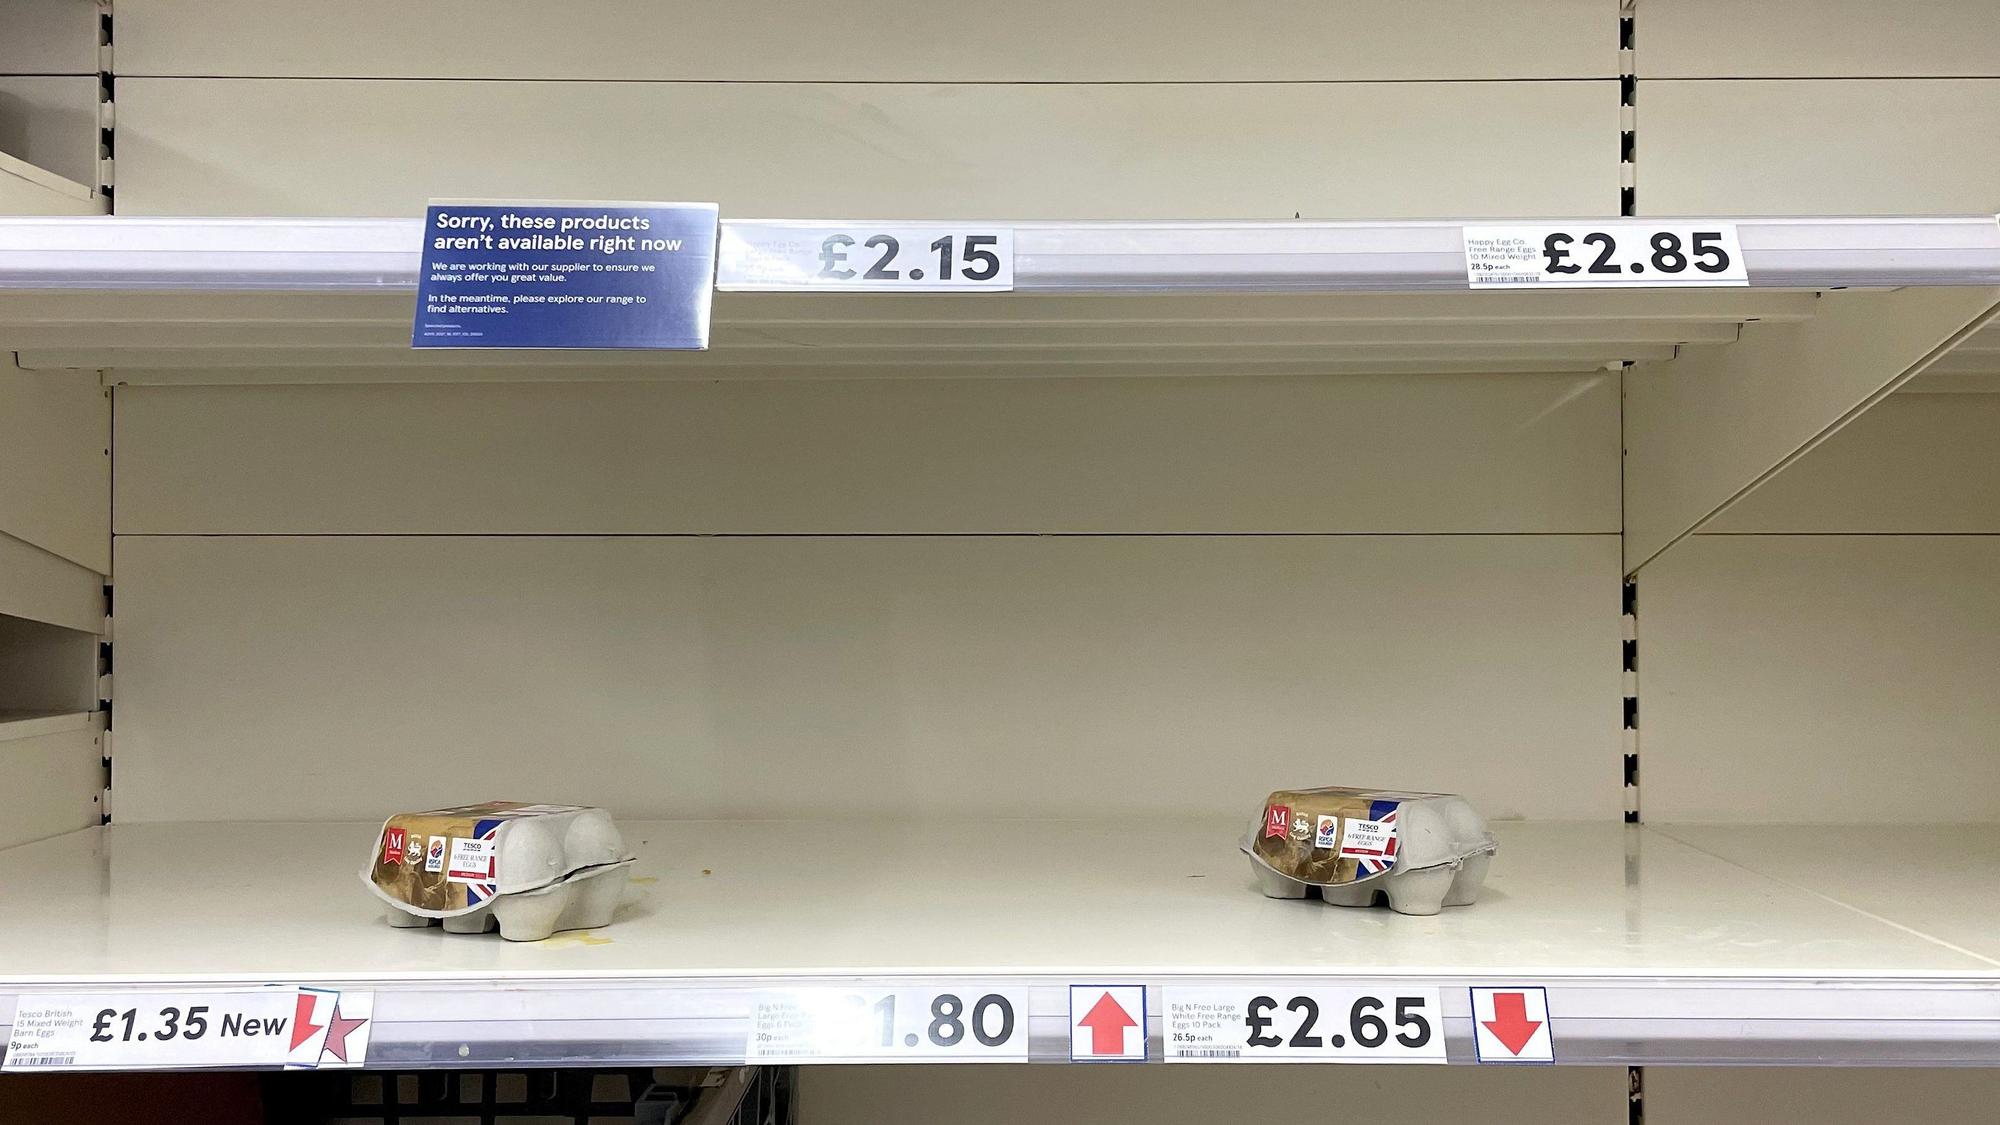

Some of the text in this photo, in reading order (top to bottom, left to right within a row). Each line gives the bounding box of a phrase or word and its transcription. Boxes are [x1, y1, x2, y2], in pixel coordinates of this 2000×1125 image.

[436, 212, 650, 232] Sorry, these products
[434, 234, 682, 254] aren't available right now
[818, 234, 1000, 281] £2.15
[1543, 232, 1730, 274] £2.85
[432, 262, 447, 270] We
[468, 262, 506, 273] working
[508, 262, 529, 272] with
[550, 263, 590, 274] supplier
[1471, 263, 1494, 271] 28.5p
[430, 272, 567, 284] always offer you great value.
[428, 294, 438, 302] In
[440, 294, 457, 302] the
[513, 295, 546, 306] please
[547, 295, 584, 306] explore
[606, 296, 634, 306] range
[427, 304, 508, 314] find alternatives.
[1358, 823, 1378, 831] TESCO
[1172, 1004, 1184, 1012] Big
[1214, 1004, 1235, 1012] Large
[44, 1010, 73, 1018] British
[1217, 1013, 1241, 1021] Range
[54, 1020, 84, 1028] Weight
[90, 1006, 288, 1042] £1.35 New
[845, 994, 1014, 1047] 1.80
[1172, 1021, 1190, 1030] Eggs
[1246, 996, 1431, 1048] £2.65
[36, 1029, 55, 1038] Eggs
[756, 1033, 772, 1042] 30p
[1173, 1033, 1196, 1043] 26.5p
[10, 1041, 22, 1050] 9p
